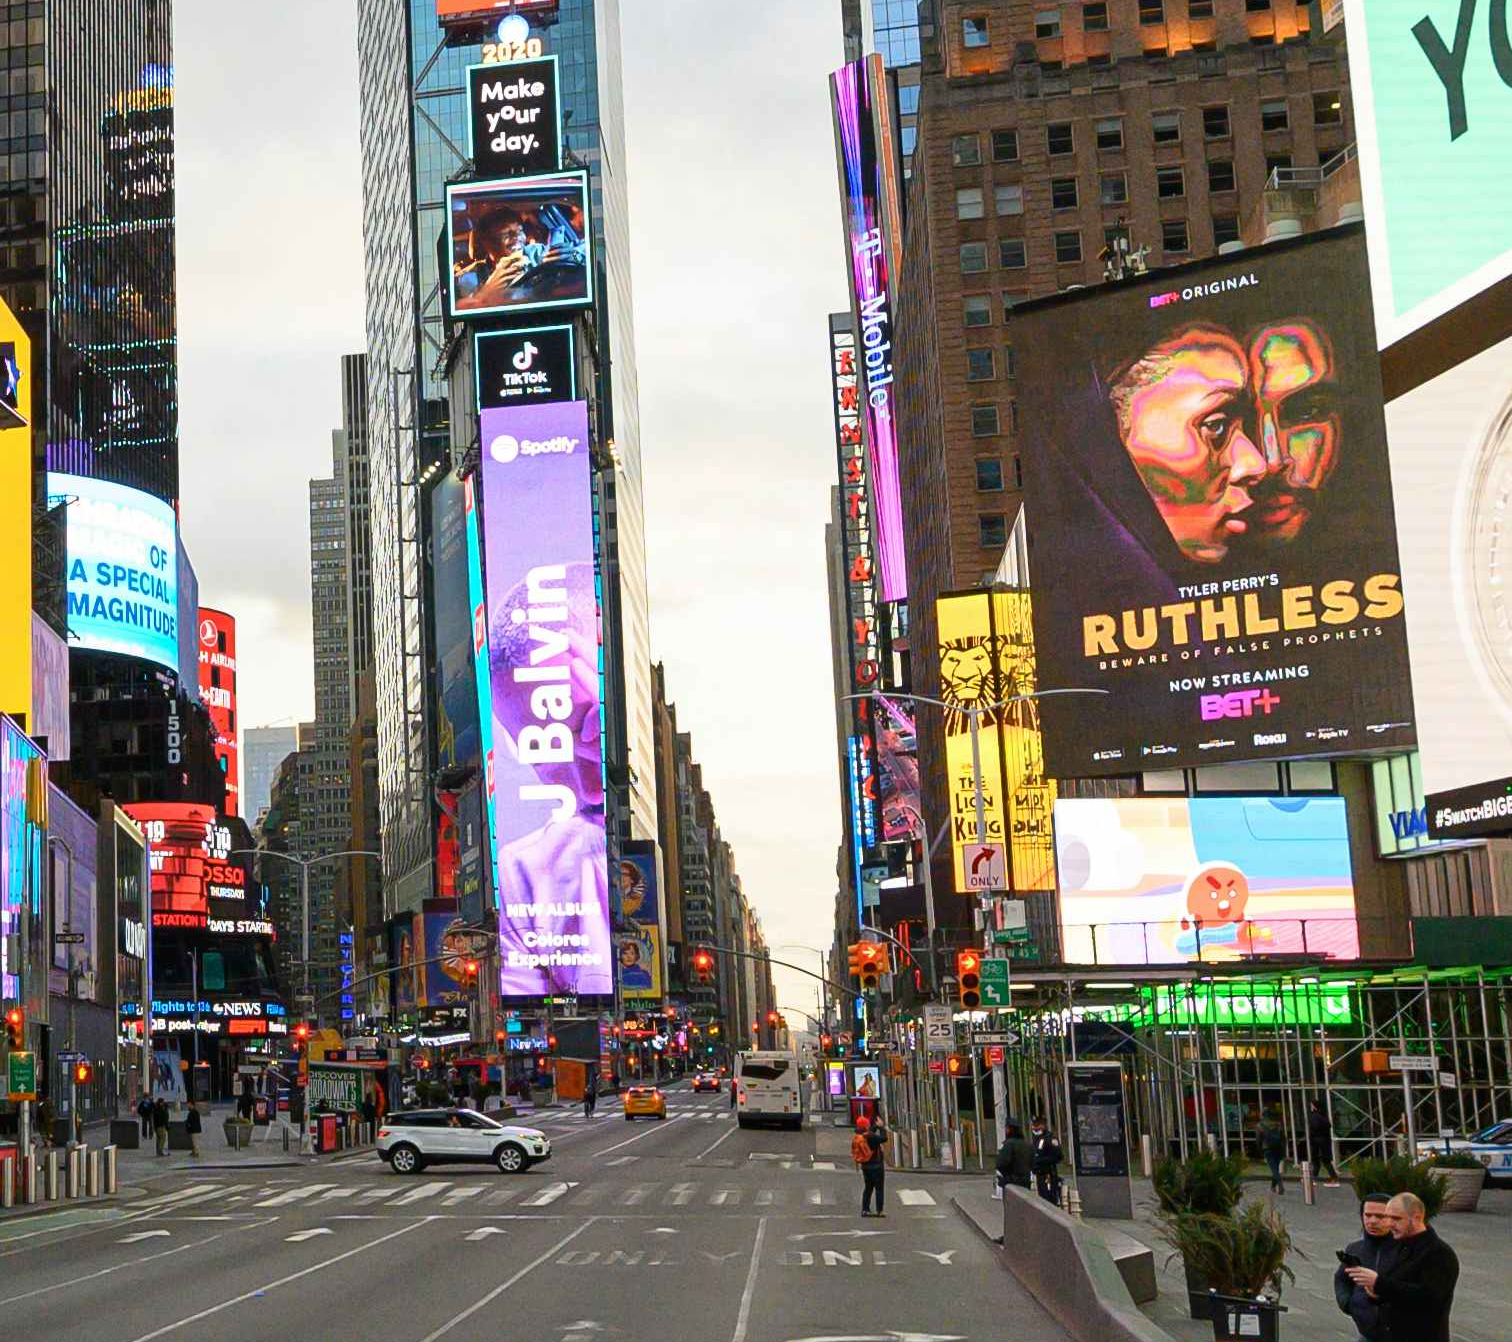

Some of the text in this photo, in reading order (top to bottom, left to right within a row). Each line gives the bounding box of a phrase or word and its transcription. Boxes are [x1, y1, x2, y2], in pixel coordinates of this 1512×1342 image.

[482, 38, 542, 65] 2020
[481, 78, 545, 103] Make
[486, 105, 541, 133] your
[491, 133, 540, 154] day.
[1182, 273, 1260, 300] ORIGINAL
[503, 371, 547, 386] TikTok
[520, 435, 579, 456] Spotify
[150, 545, 168, 572] OF
[69, 559, 170, 604] A SPECIAL
[1178, 573, 1280, 600] TYLER PERRY'S
[1083, 572, 1405, 659] RUTHLESS
[1100, 627, 1383, 671] BEWARE OF FALSE PROPHETS
[1169, 664, 1311, 693] NOW STREAMING
[513, 563, 577, 822] J Balvin
[1200, 688, 1281, 722] BET+
[168, 700, 181, 765] 1500
[970, 877, 1000, 888] ONLY
[153, 914, 198, 927] STATION
[506, 902, 602, 918] NEW ALBUM
[523, 931, 590, 947] Colores
[507, 950, 603, 969] Experience
[223, 1002, 261, 1016] NEWS
[929, 1024, 952, 1036] 25
[777, 1249, 958, 1266] ONLY
